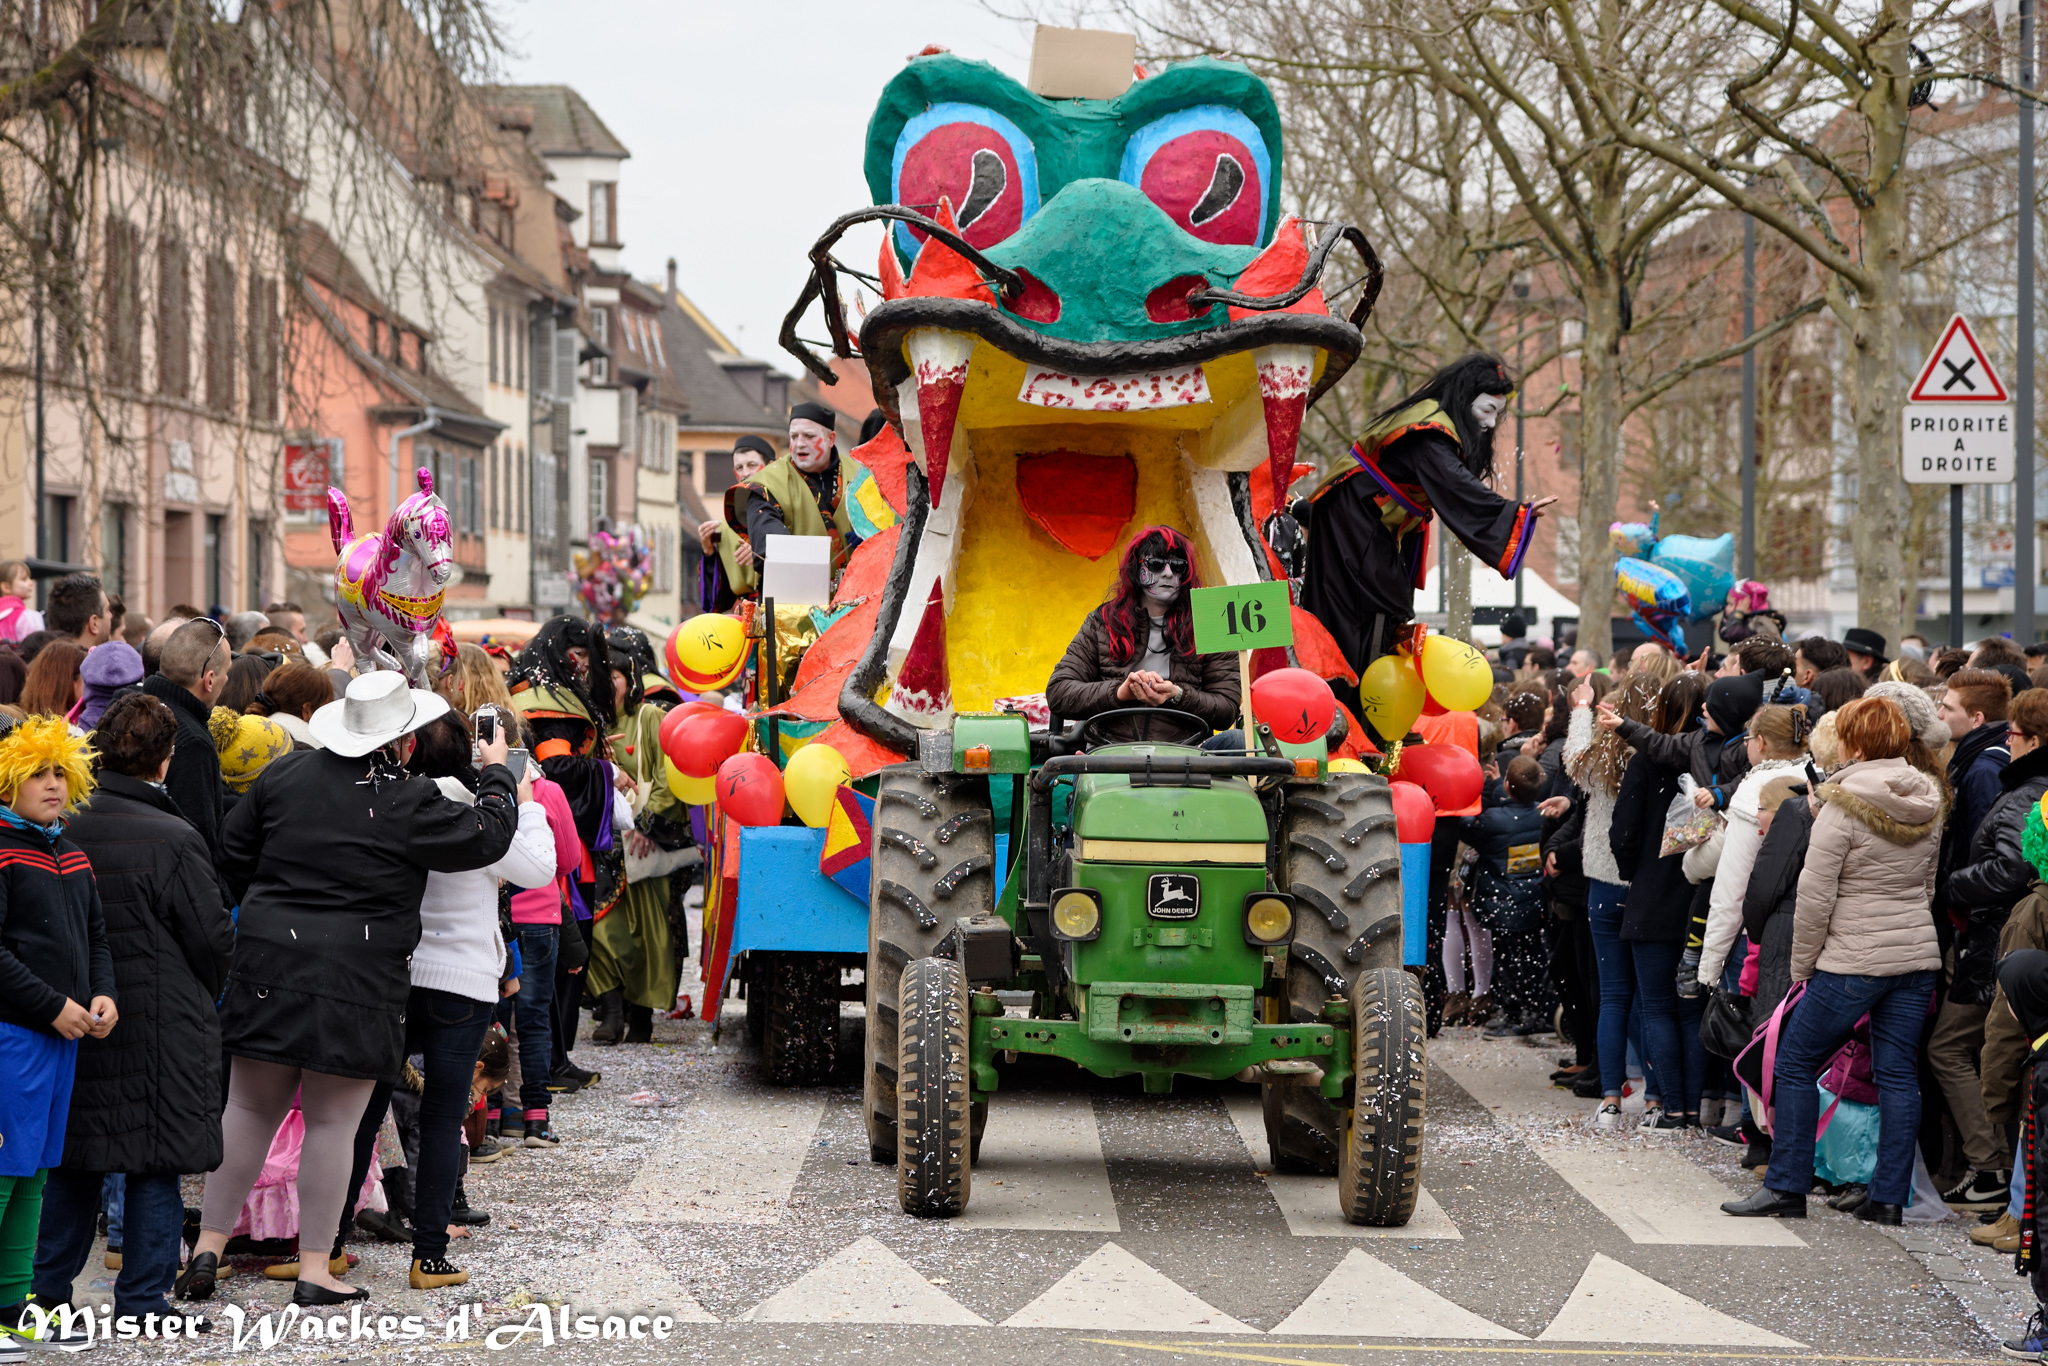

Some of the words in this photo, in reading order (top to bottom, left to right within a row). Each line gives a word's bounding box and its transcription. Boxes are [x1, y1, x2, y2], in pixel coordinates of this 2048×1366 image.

[1910, 414, 2008, 432] PRIORITÉ
[1954, 437, 1965, 452] A
[1922, 457, 1997, 471] DROITE
[1221, 599, 1267, 636] 16
